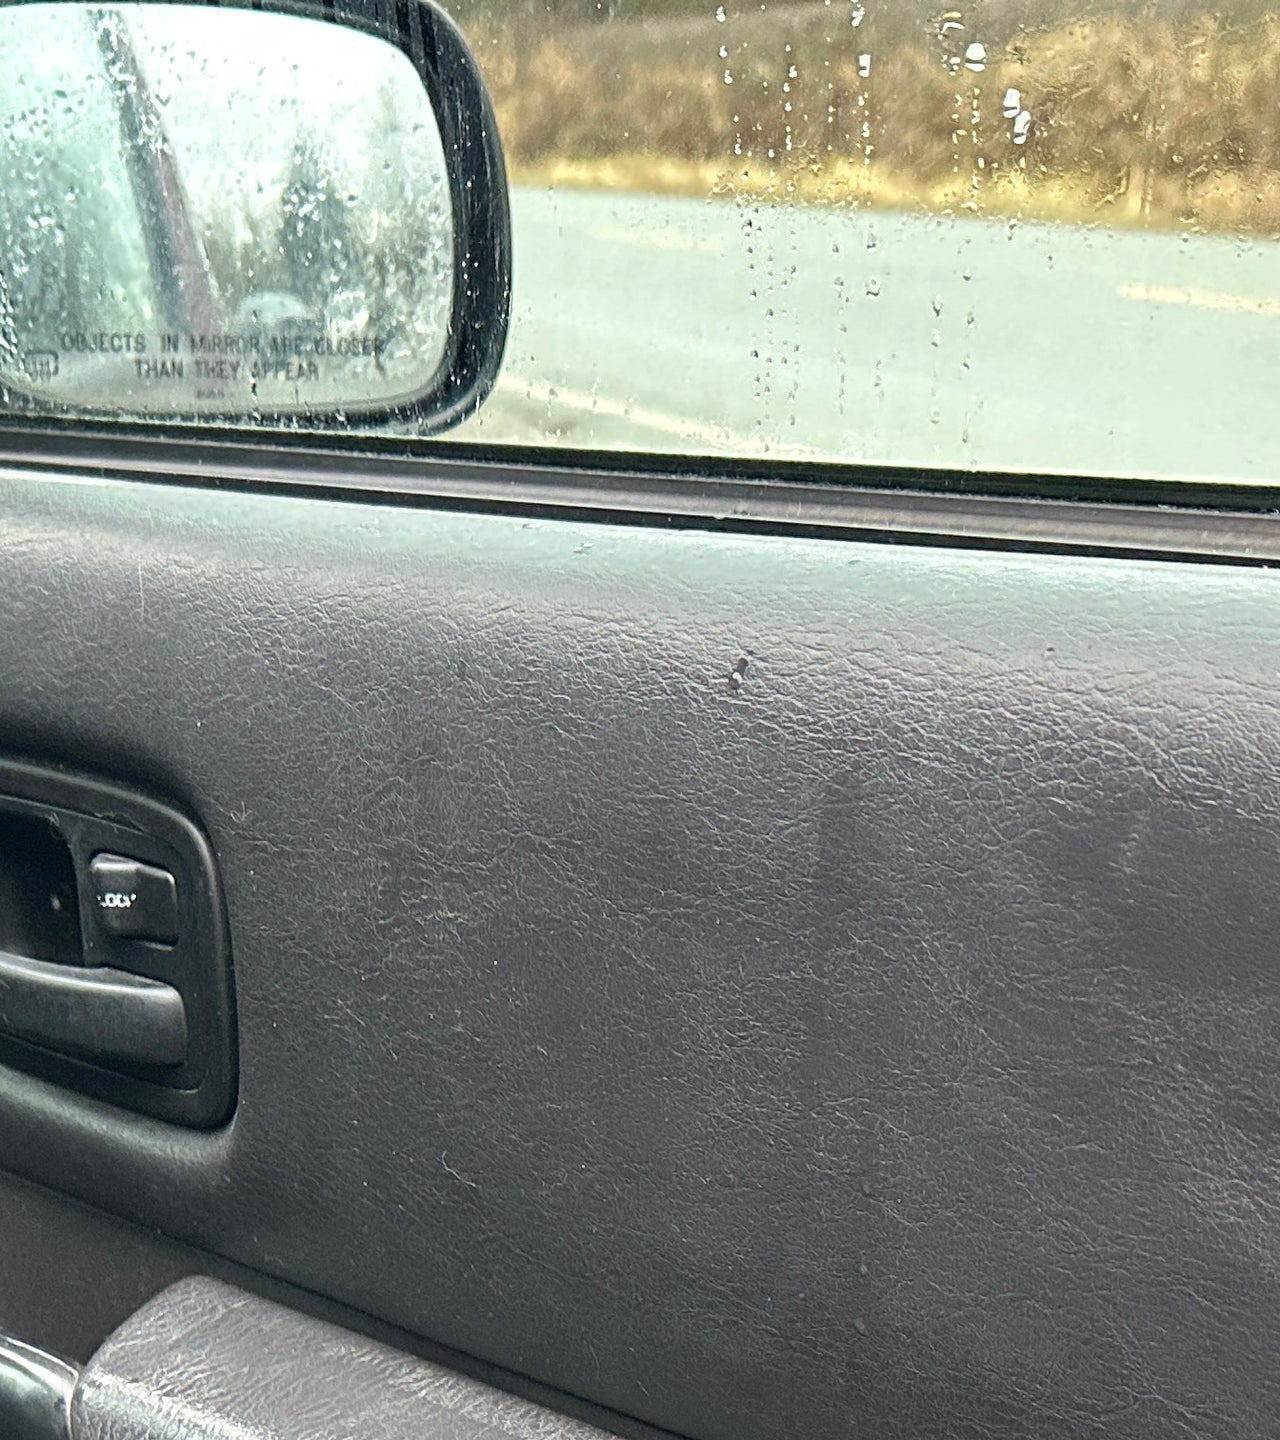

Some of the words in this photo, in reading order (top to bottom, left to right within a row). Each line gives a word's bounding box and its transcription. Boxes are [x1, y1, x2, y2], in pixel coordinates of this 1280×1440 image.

[61, 331, 147, 353] OBJECTS
[160, 333, 180, 352] IN
[190, 333, 261, 354] MIRROR
[270, 335, 307, 354] ARE
[314, 336, 387, 357] CLOSER
[134, 357, 184, 379] THAN
[195, 358, 241, 380] THEY
[250, 359, 320, 381] APPEAR
